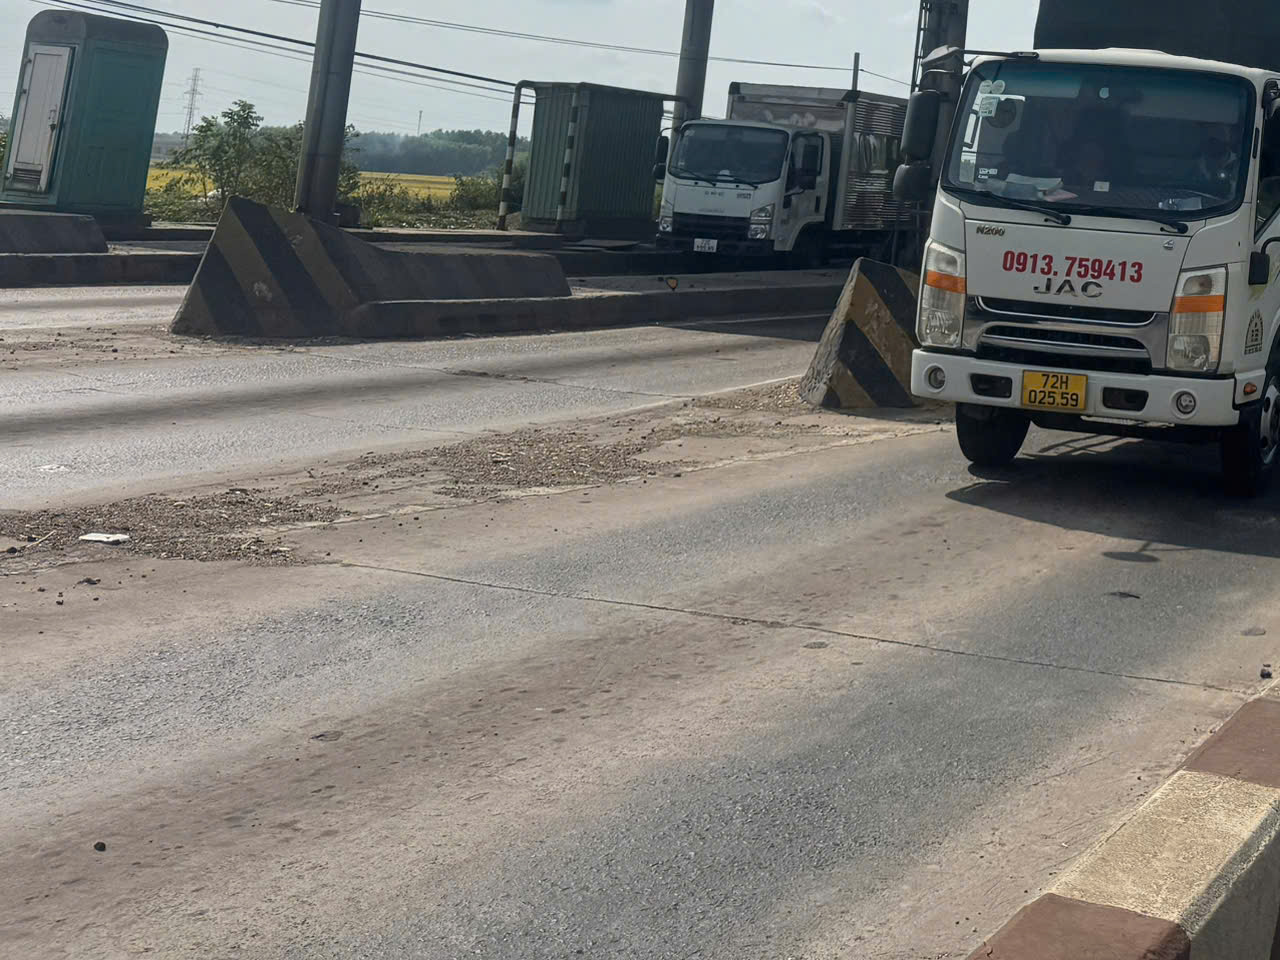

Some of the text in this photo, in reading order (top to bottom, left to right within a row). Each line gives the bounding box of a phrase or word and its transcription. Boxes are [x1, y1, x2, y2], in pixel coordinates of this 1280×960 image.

[1033, 278, 1104, 299] JAC
[1041, 374, 1070, 390] 72H
[1028, 390, 1080, 408] 025.59
